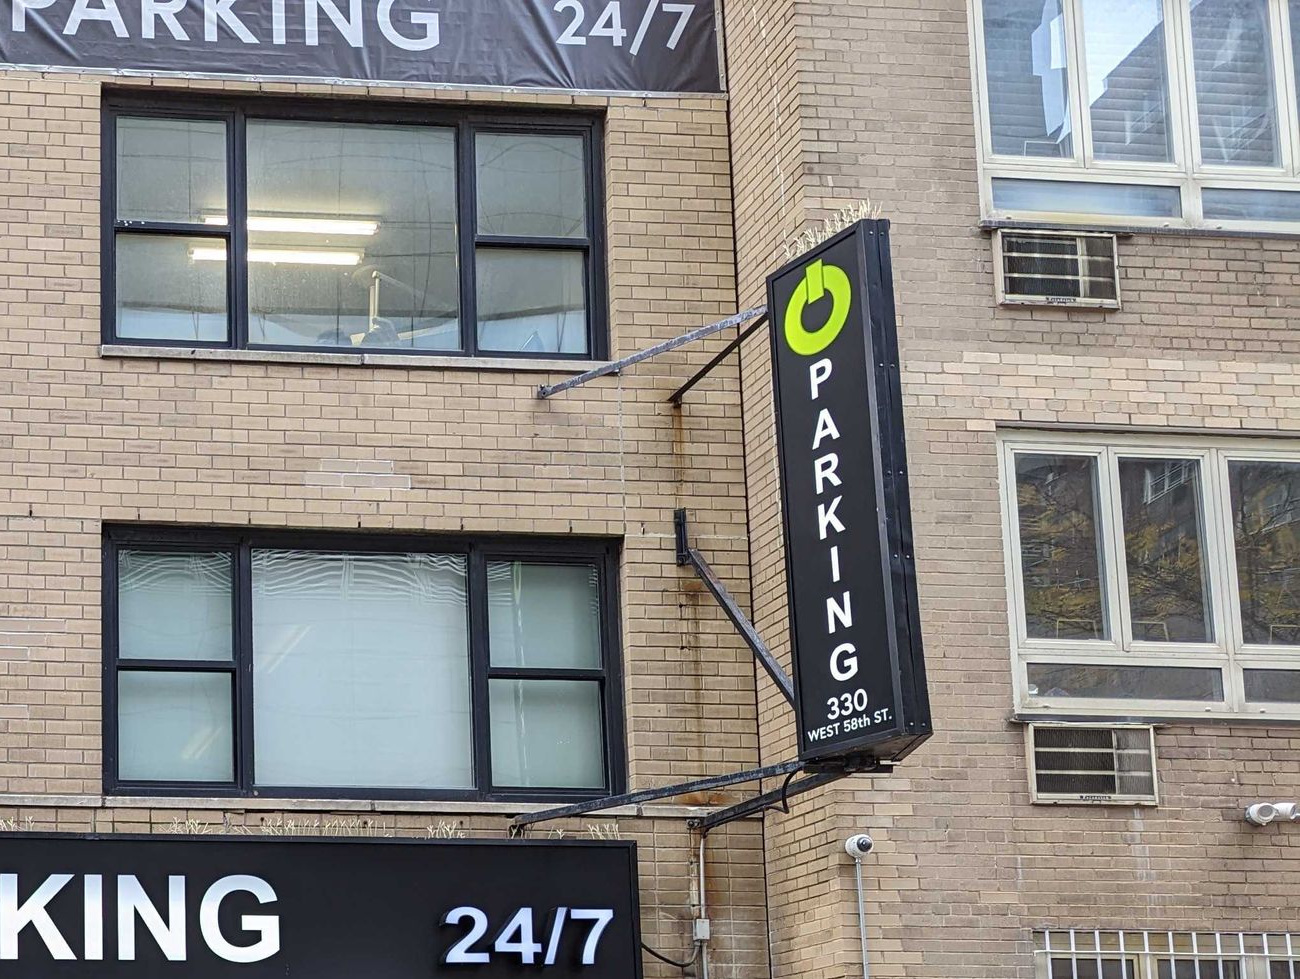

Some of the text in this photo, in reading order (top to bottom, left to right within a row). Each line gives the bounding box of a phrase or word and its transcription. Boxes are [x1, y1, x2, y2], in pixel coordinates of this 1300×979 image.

[11, 0, 695, 56] PARKING 24/7
[808, 357, 859, 682] PARKING
[807, 707, 892, 742] WEST 58th ST.
[827, 688, 868, 720] 330
[445, 906, 614, 965] 24/7
